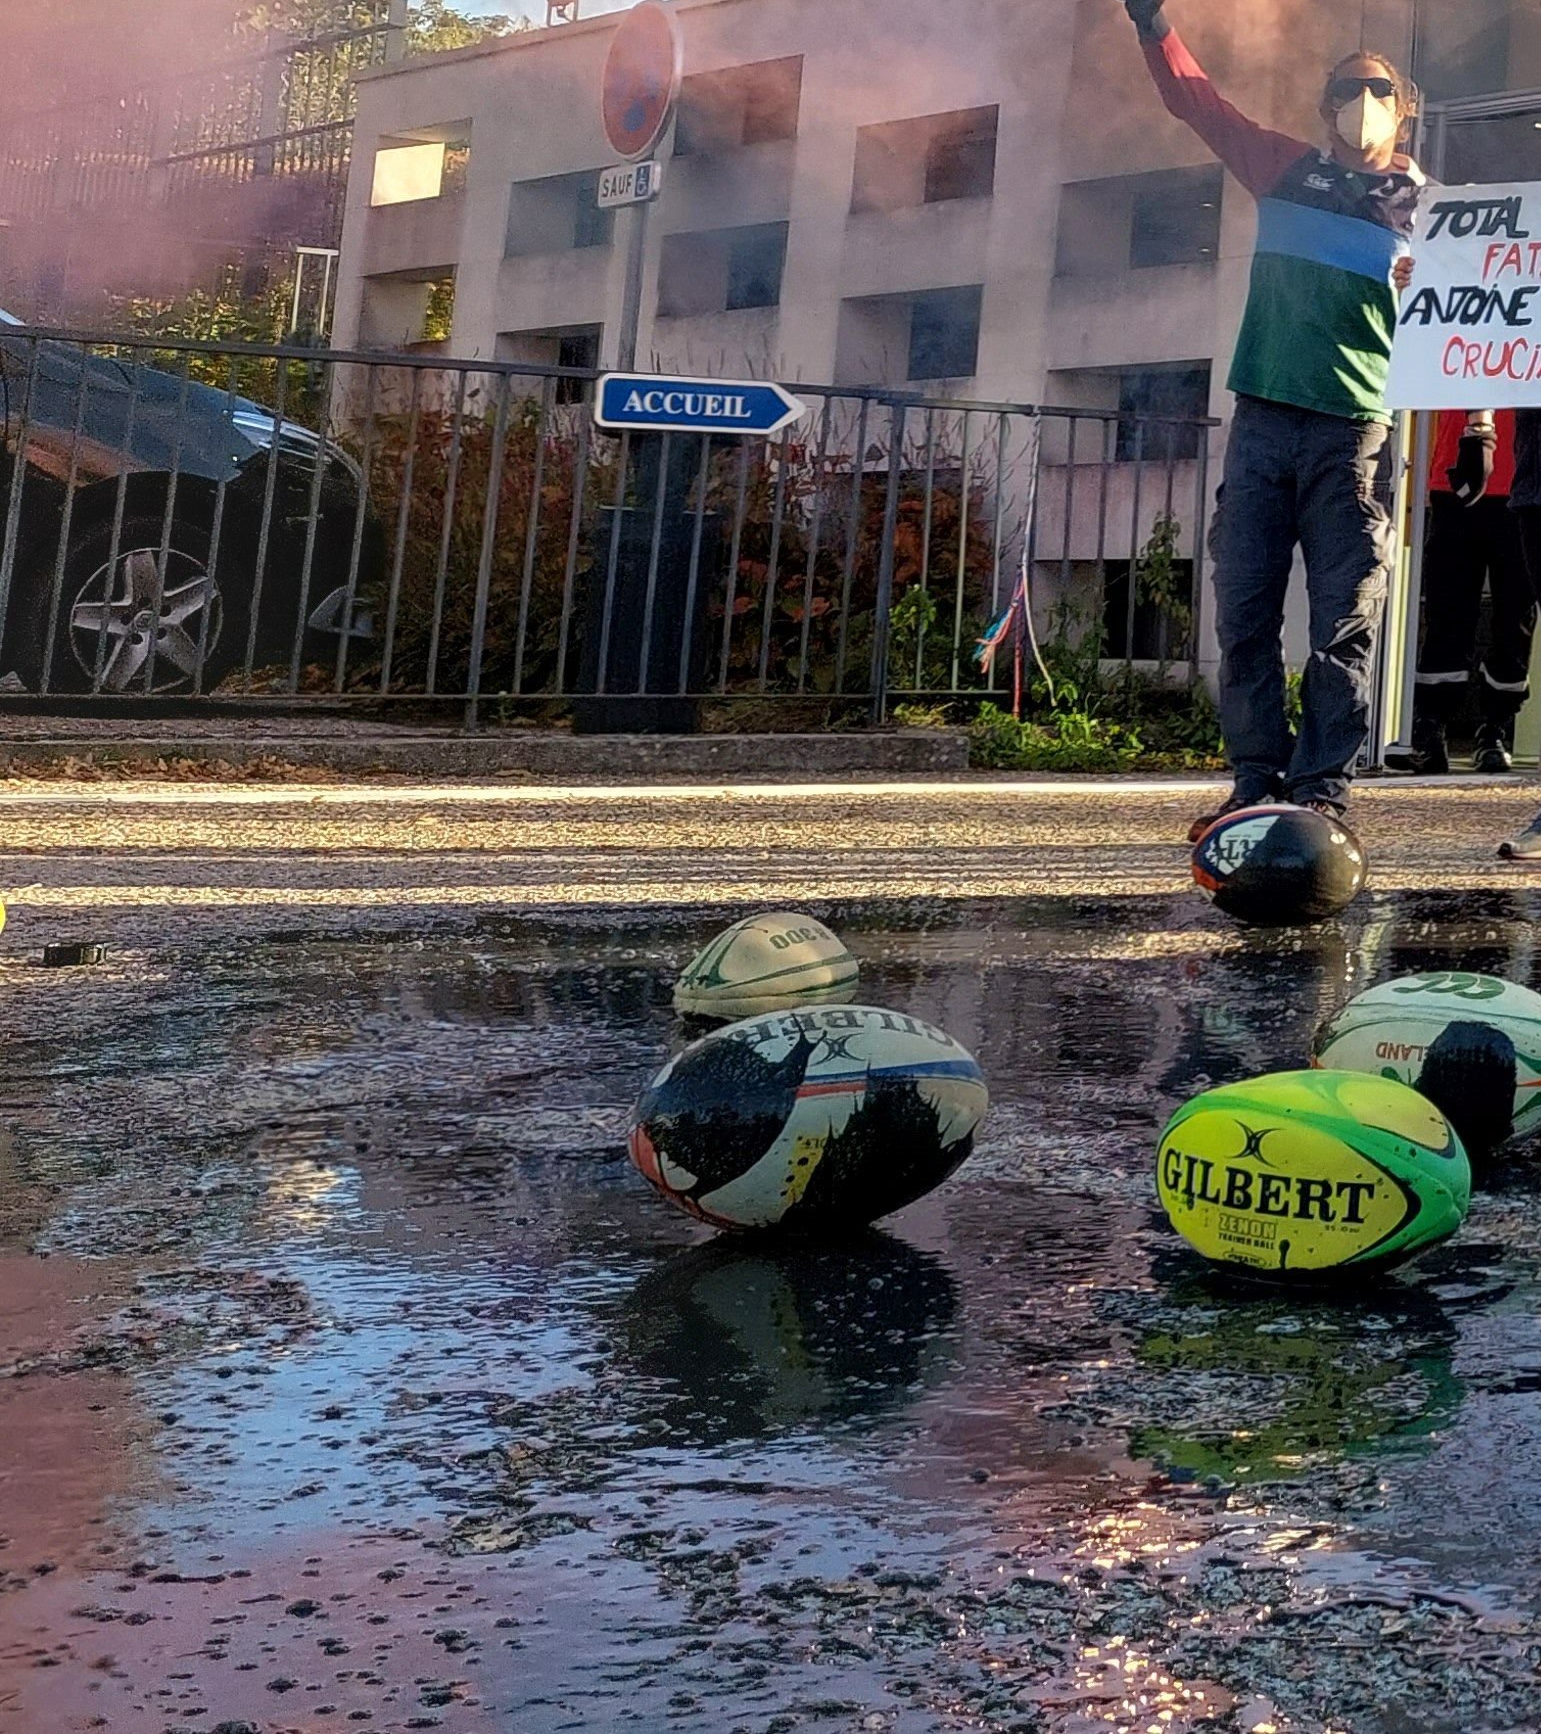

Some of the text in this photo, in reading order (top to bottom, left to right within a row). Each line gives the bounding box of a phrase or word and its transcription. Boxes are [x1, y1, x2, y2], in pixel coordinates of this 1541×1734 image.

[601, 172, 633, 198] SAUF
[1426, 196, 1529, 241] TOTAL
[622, 390, 753, 418] ACCUEIL
[1375, 1040, 1429, 1063] LAND
[1163, 1147, 1376, 1225] GILBERT
[1217, 1212, 1279, 1241] ZENON
